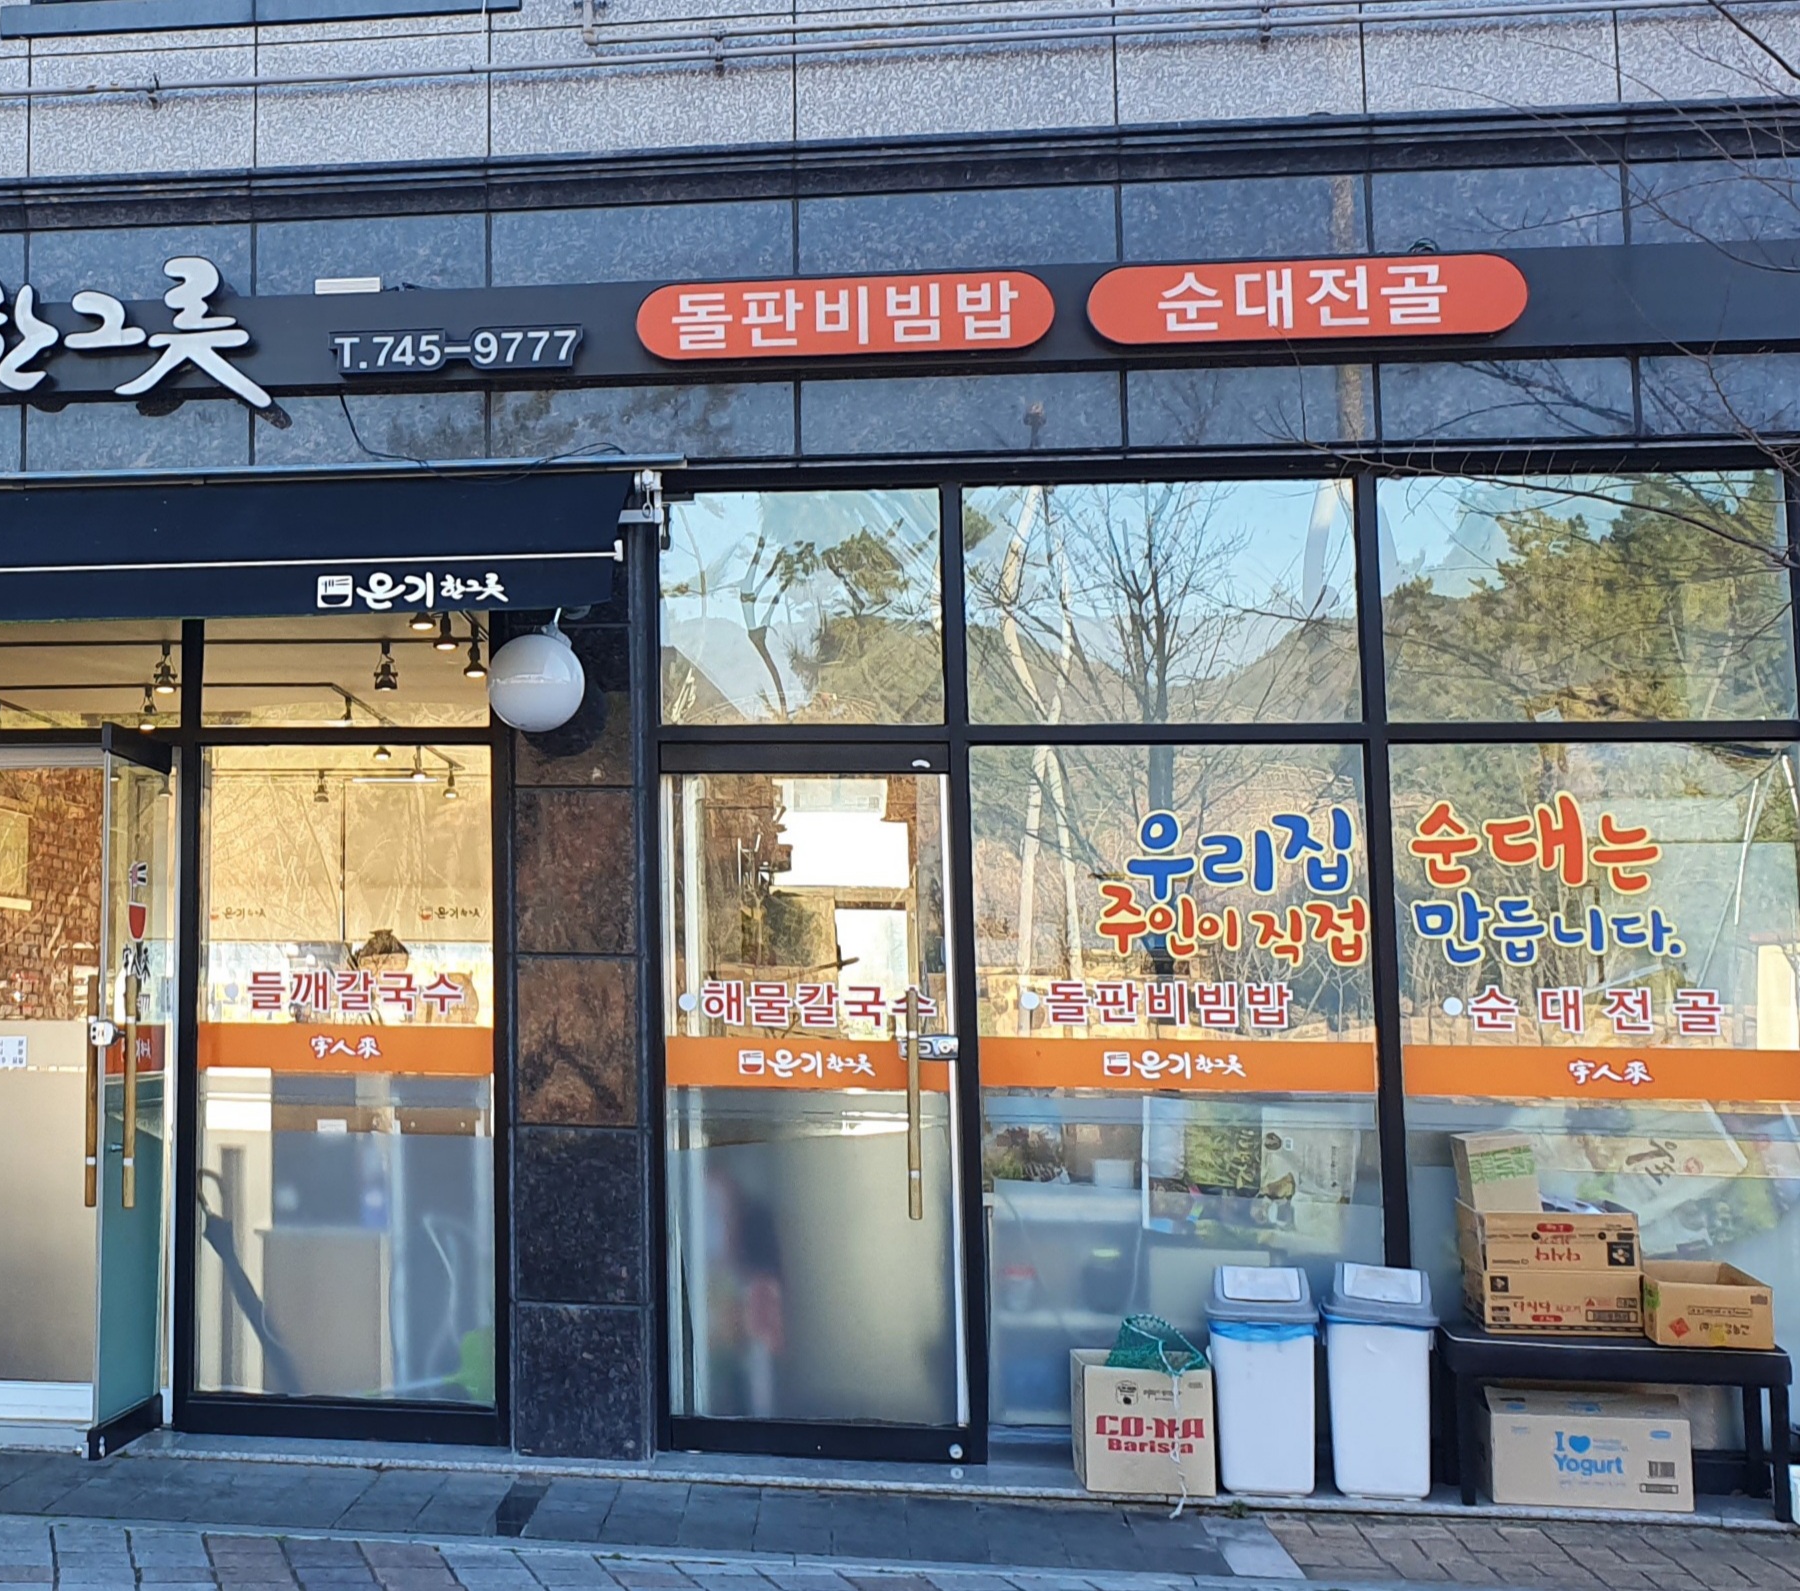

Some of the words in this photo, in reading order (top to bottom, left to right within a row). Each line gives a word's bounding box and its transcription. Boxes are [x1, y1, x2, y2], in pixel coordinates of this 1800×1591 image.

[670, 280, 1022, 350] 돌판비빔밥
[1157, 266, 1450, 332] 순대전골
[333, 329, 578, 370] T.745-9777
[356, 572, 434, 609] 온기
[440, 573, 508, 602] 한그릇
[1126, 807, 1354, 902] 우리집
[1409, 789, 1662, 892] 순대는
[1098, 883, 1239, 956] 주인이
[1249, 897, 1368, 965] 직접
[1412, 890, 1686, 965] 만듭니다.
[247, 971, 464, 1014] 들깨칼국수
[701, 980, 938, 1027] 해물칼국수
[1044, 981, 1293, 1029] 돌판비빔밥
[1468, 986, 1724, 1037] 순대전골
[767, 1049, 823, 1078] 온기
[827, 1053, 876, 1077] 한그릇
[1133, 1050, 1192, 1080] 온기
[1195, 1056, 1247, 1078] 한그릇
[1108, 1438, 1194, 1455] Barista
[1554, 1454, 1624, 1476] Yogurt
[1555, 1431, 1564, 1452] I
